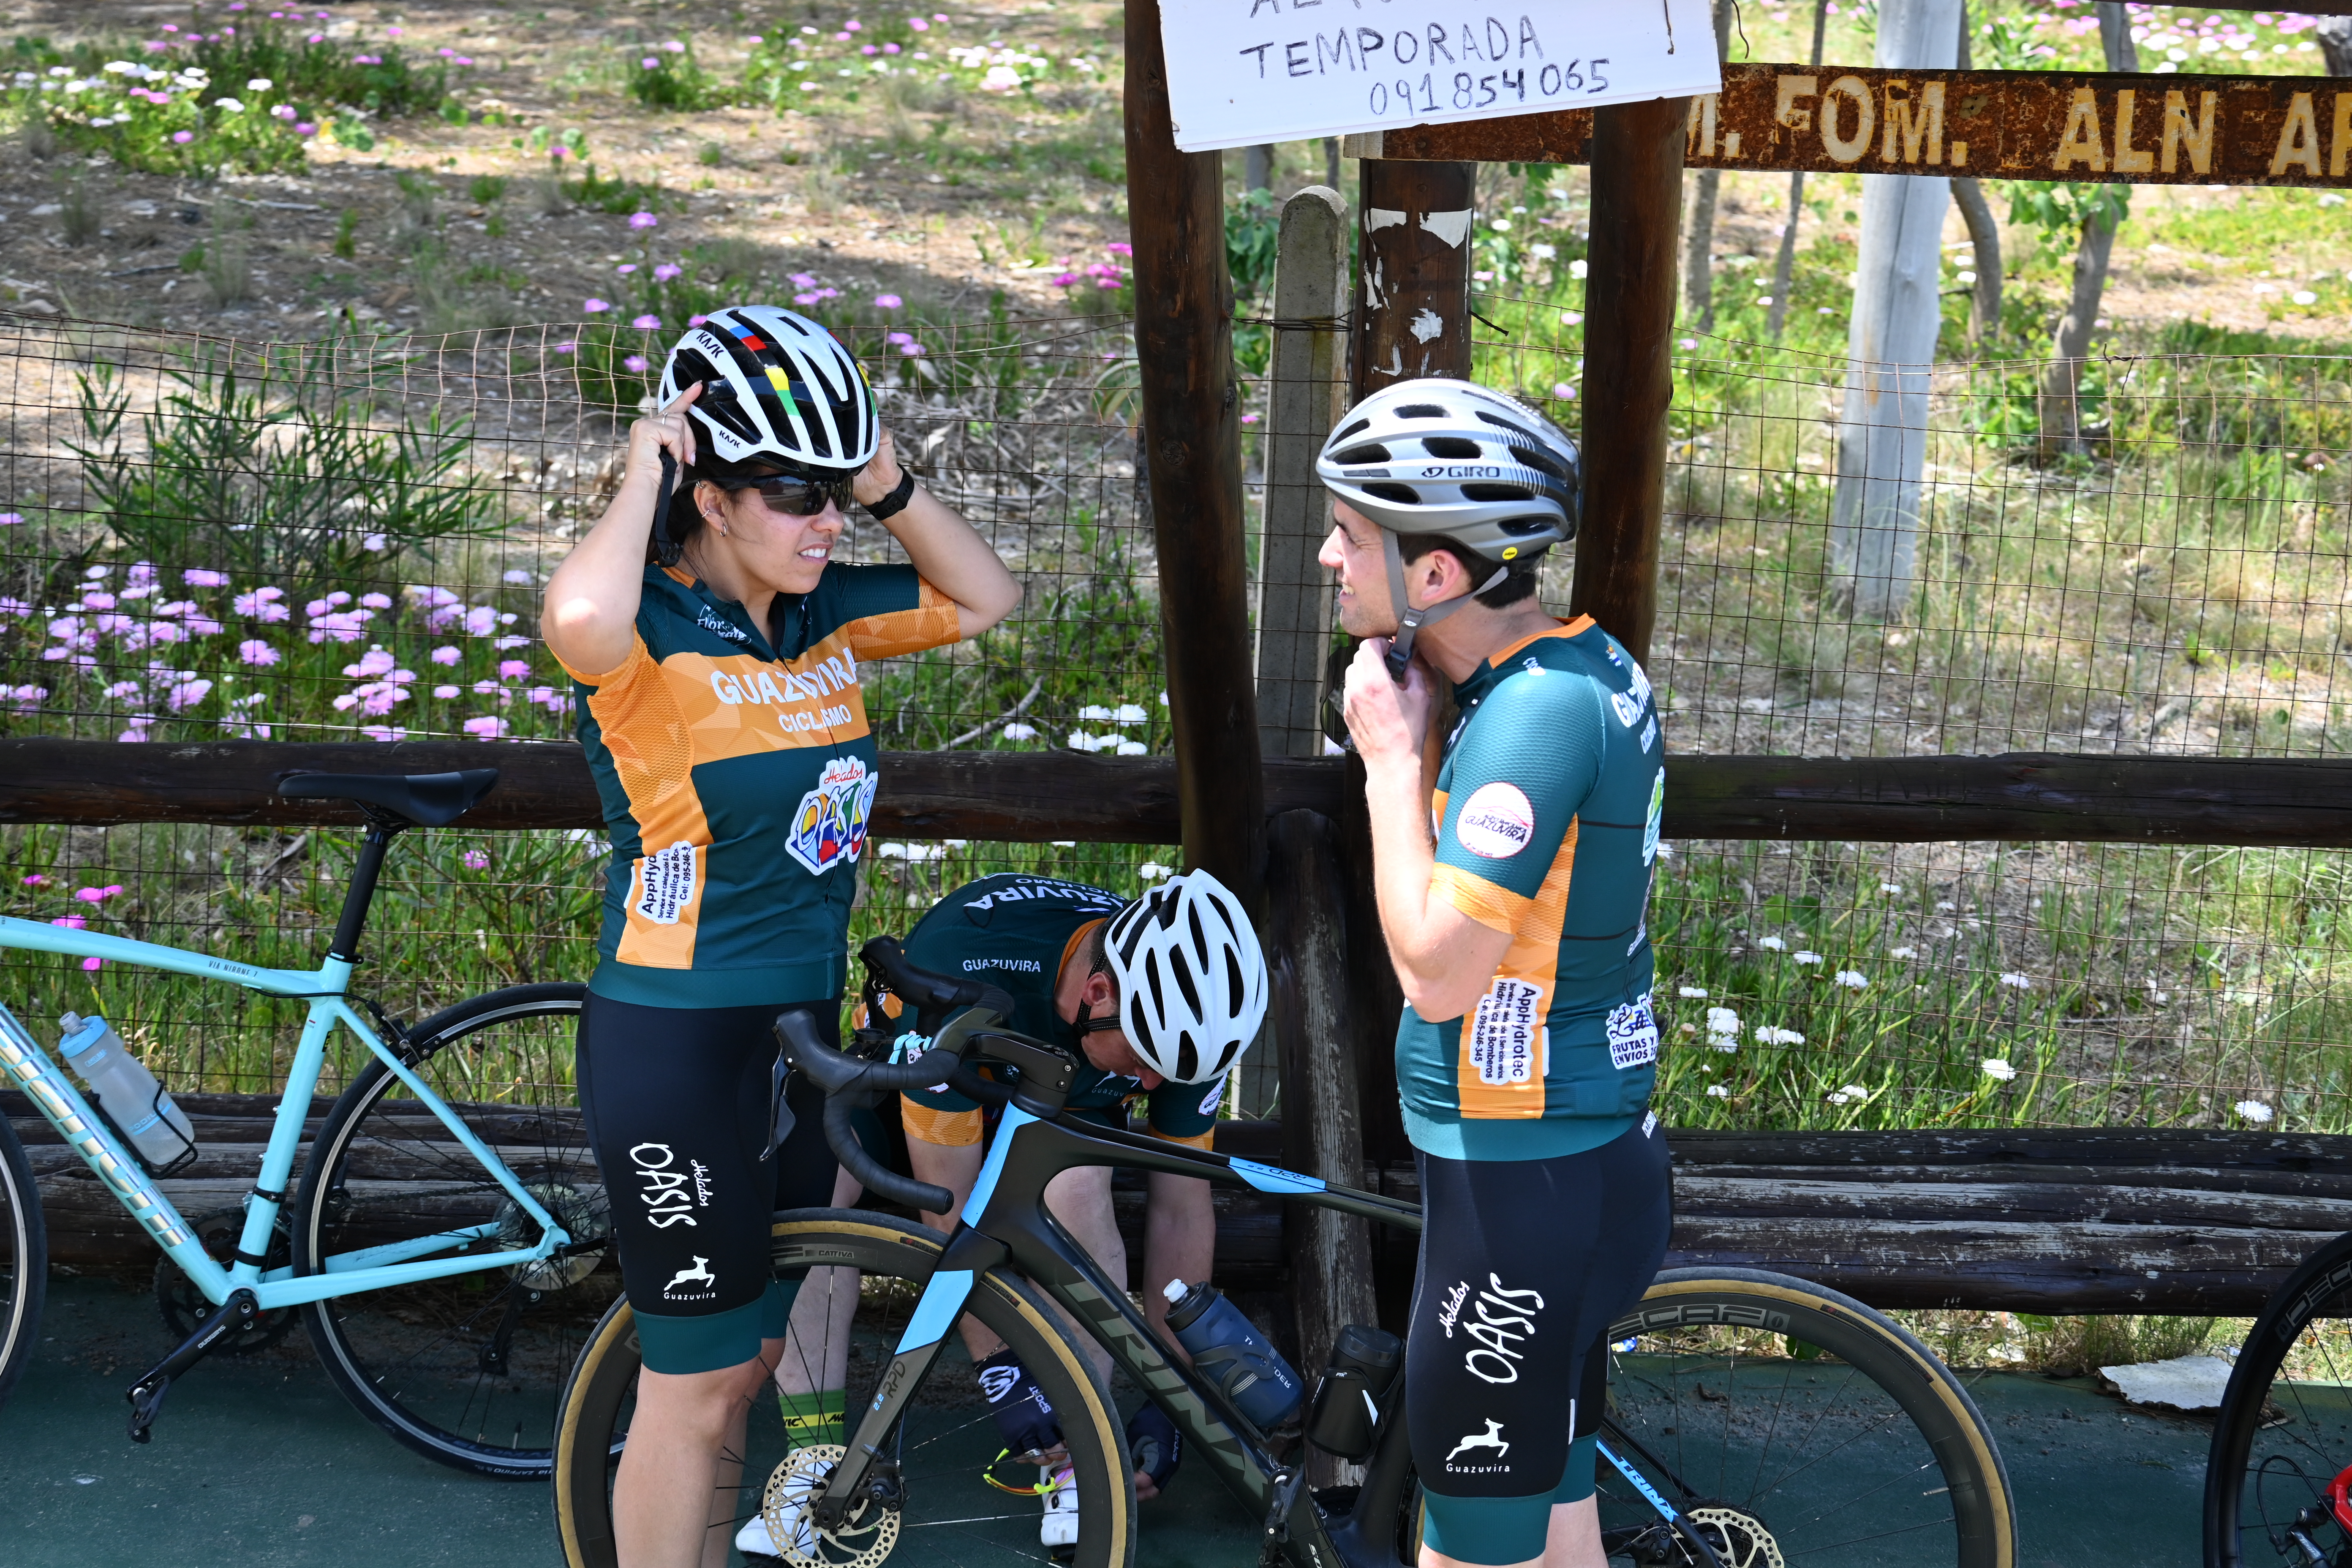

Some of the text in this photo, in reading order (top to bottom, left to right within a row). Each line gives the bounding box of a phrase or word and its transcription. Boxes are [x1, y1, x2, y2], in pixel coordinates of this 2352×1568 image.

[1239, 15, 1544, 78] TEMPORADA
[696, 331, 725, 359] KASK
[719, 430, 740, 449] KASK
[1448, 466, 1500, 478] GIRO
[797, 780, 874, 851] OASIS
[672, 864, 680, 872] de
[666, 874, 680, 918] Hidráulica
[680, 883, 690, 900] Cel:
[1015, 878, 1125, 900] CICLISMO
[208, 960, 221, 971] VIA
[963, 959, 1041, 972] GUAZUVIRA
[1475, 1015, 1487, 1062] 095-246-345
[1489, 1025, 1498, 1034] de
[1511, 987, 1536, 1077] AppHydrotec
[1486, 1037, 1497, 1078] Bomberos
[1612, 1038, 1647, 1054] FRUTAS
[1614, 1051, 1648, 1065] ENVIOS
[1091, 1086, 1129, 1097] Guazuv
[629, 1143, 697, 1228] OASIS
[690, 1159, 713, 1206] Helados
[1269, 1168, 1307, 1181] RPD
[818, 1250, 854, 1259] CATTIVA
[664, 1291, 716, 1301] Guazuvira
[2288, 1261, 2352, 1327] DEC
[1438, 1281, 1470, 1338] Helados
[198, 1325, 227, 1349] SHIMANO
[1463, 1272, 1544, 1383] OASIS
[883, 1359, 906, 1399] RPD
[1064, 1265, 1268, 1500] TRINX
[873, 1393, 884, 1411] 2.2
[1028, 1386, 1052, 1414] SPORT
[1446, 1463, 1510, 1473] Guazuvira
[1617, 1456, 1679, 1522] TRINX
